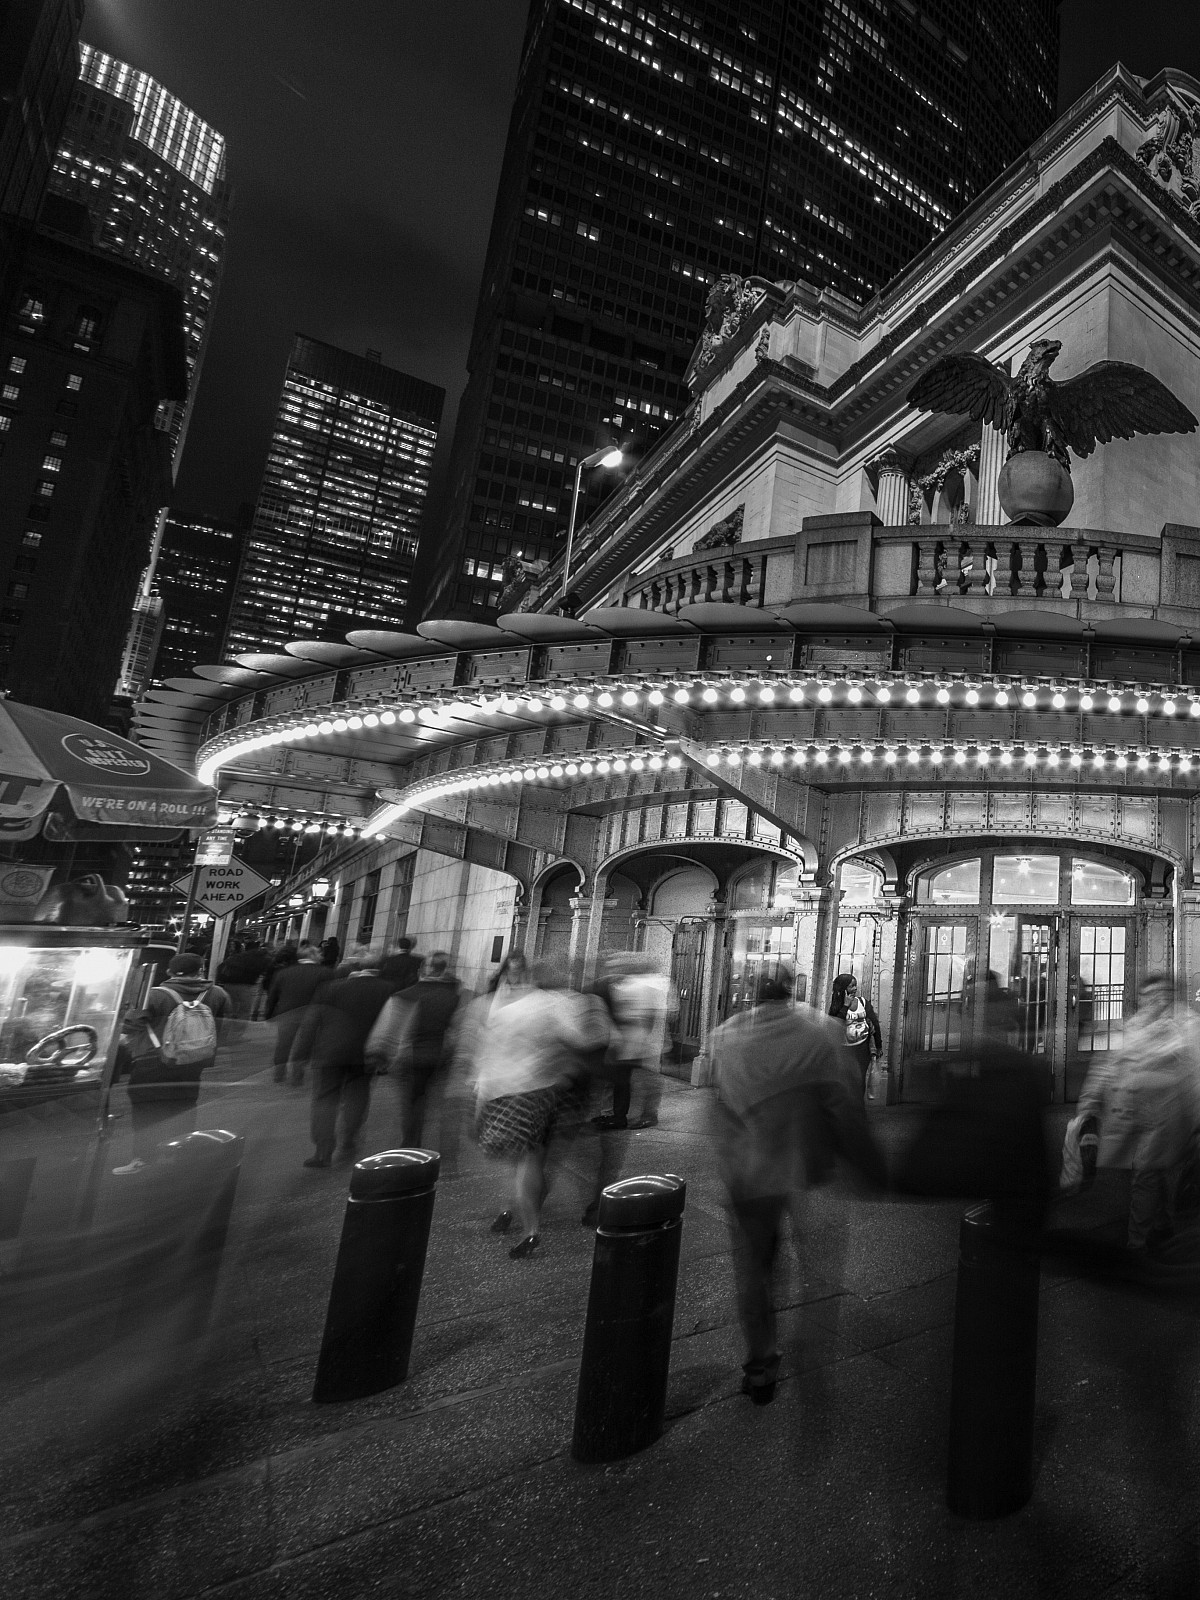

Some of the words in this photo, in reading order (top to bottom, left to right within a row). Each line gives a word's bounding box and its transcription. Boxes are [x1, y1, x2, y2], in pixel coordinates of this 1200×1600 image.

[82, 796, 125, 809] WE'RE
[127, 801, 146, 811] ON
[146, 802, 157, 812] A
[161, 803, 189, 814] ROLL
[209, 868, 244, 877] ROAD
[206, 881, 241, 889] WORK
[201, 893, 244, 902] AHEAD
